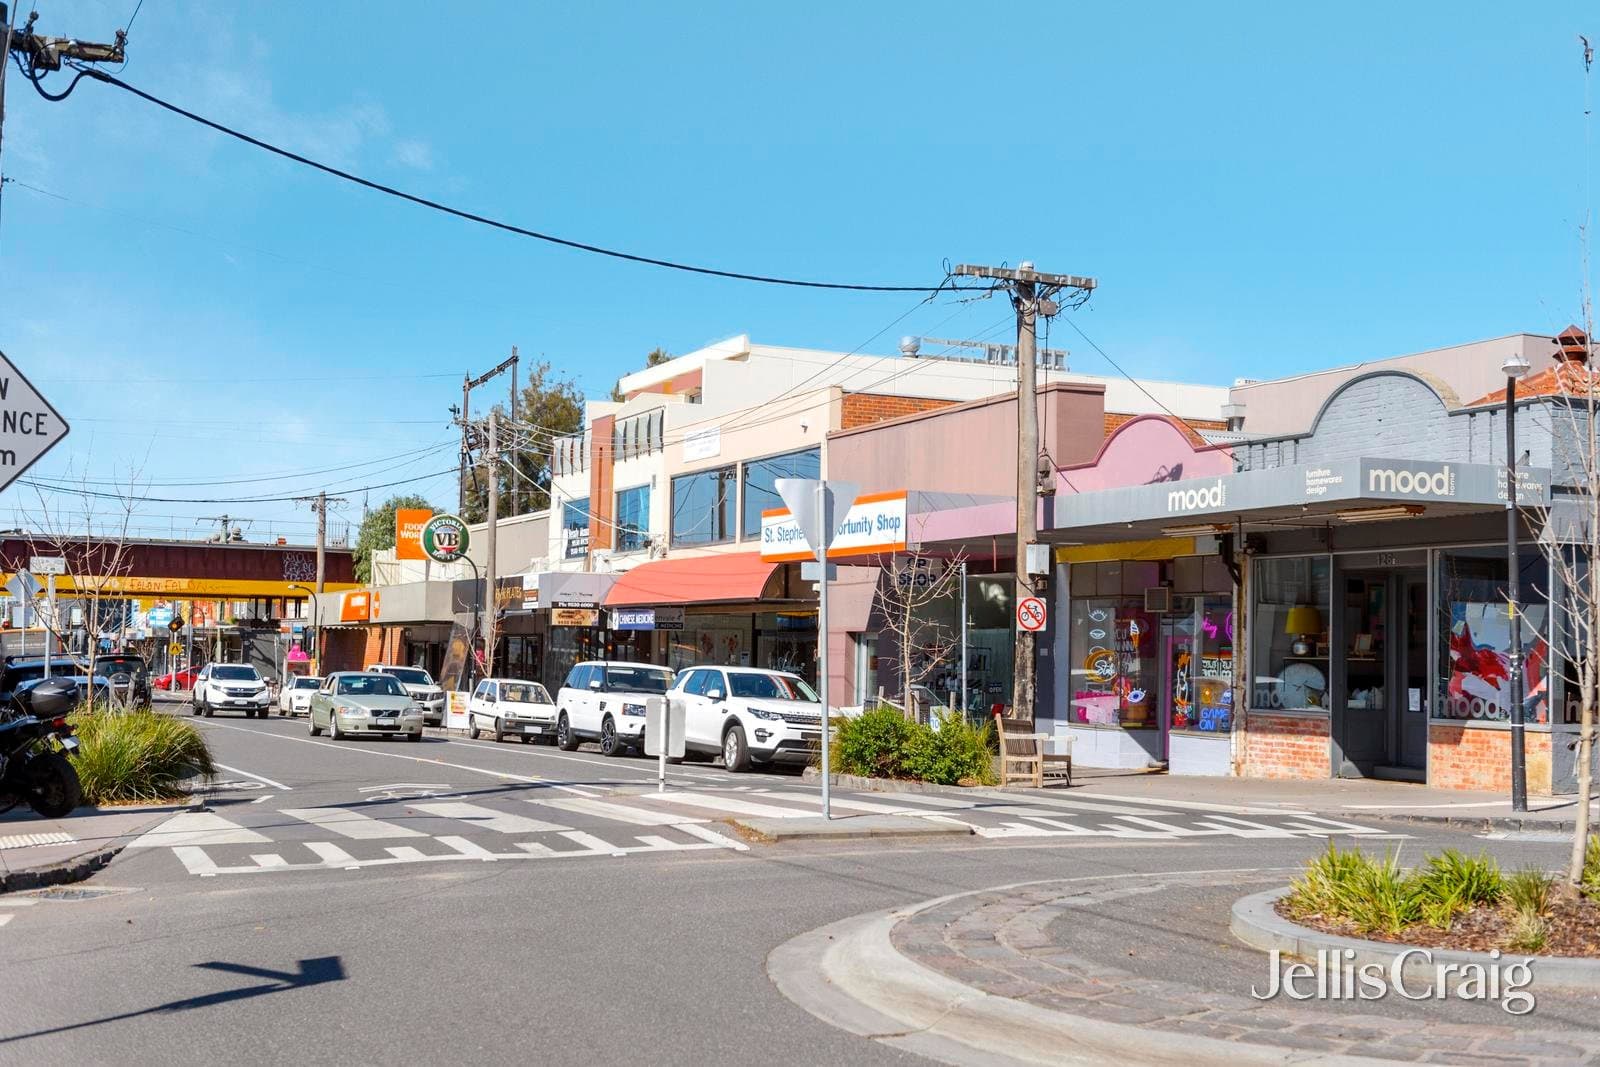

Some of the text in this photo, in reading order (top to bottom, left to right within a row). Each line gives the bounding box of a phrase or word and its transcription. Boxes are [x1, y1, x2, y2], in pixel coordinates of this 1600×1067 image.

[3, 410, 48, 436] NCE
[1369, 465, 1450, 496] mood
[1497, 469, 1529, 479] furure
[1168, 479, 1222, 512] mood
[1305, 485, 1327, 495] design
[1497, 490, 1524, 501] degn
[429, 519, 464, 532] VICTORIA
[764, 513, 901, 545] St. Stephe ortunity Shop
[436, 532, 459, 546] VB
[1201, 707, 1229, 719] GAME
[1200, 719, 1217, 731] ON
